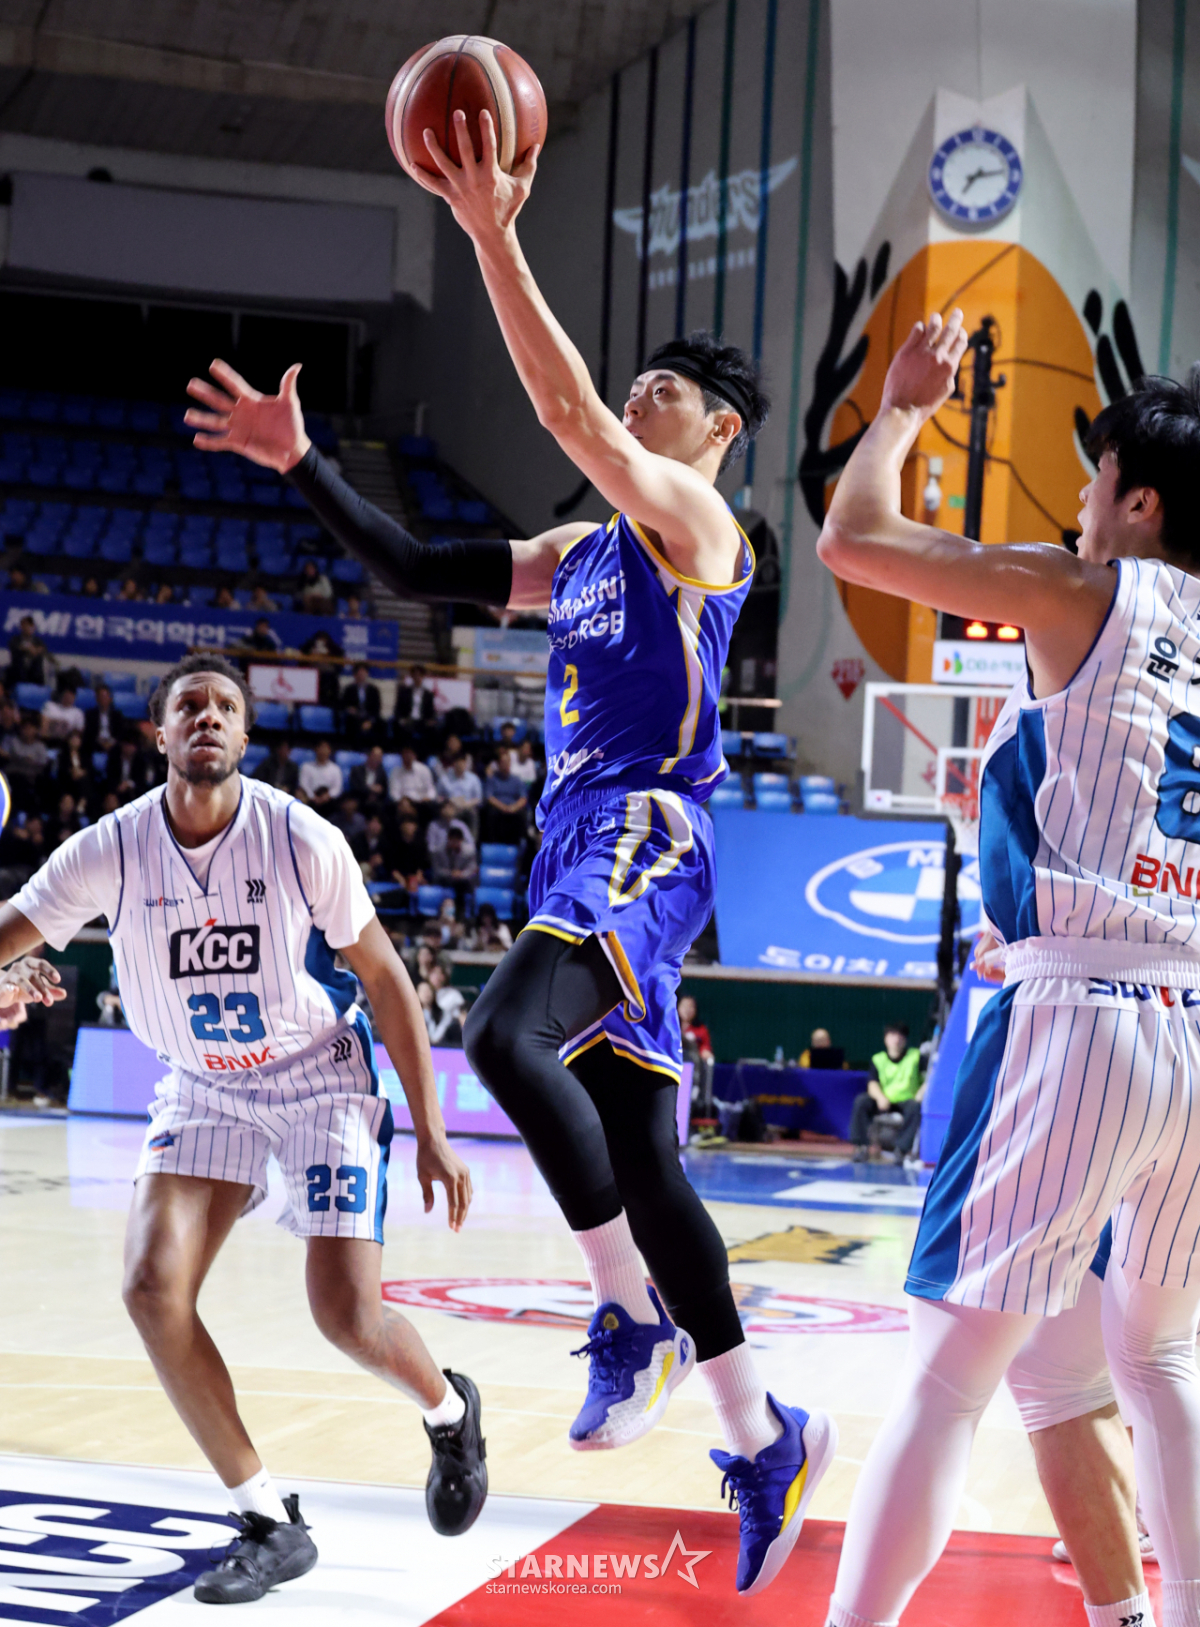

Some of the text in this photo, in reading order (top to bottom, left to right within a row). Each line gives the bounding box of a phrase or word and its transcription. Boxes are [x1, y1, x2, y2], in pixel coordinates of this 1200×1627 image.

[579, 610, 624, 643] RGB
[559, 664, 580, 728] 2
[1130, 853, 1200, 900] BN
[179, 919, 253, 973] KCC
[187, 992, 267, 1043] 23
[305, 1164, 367, 1214] 23
